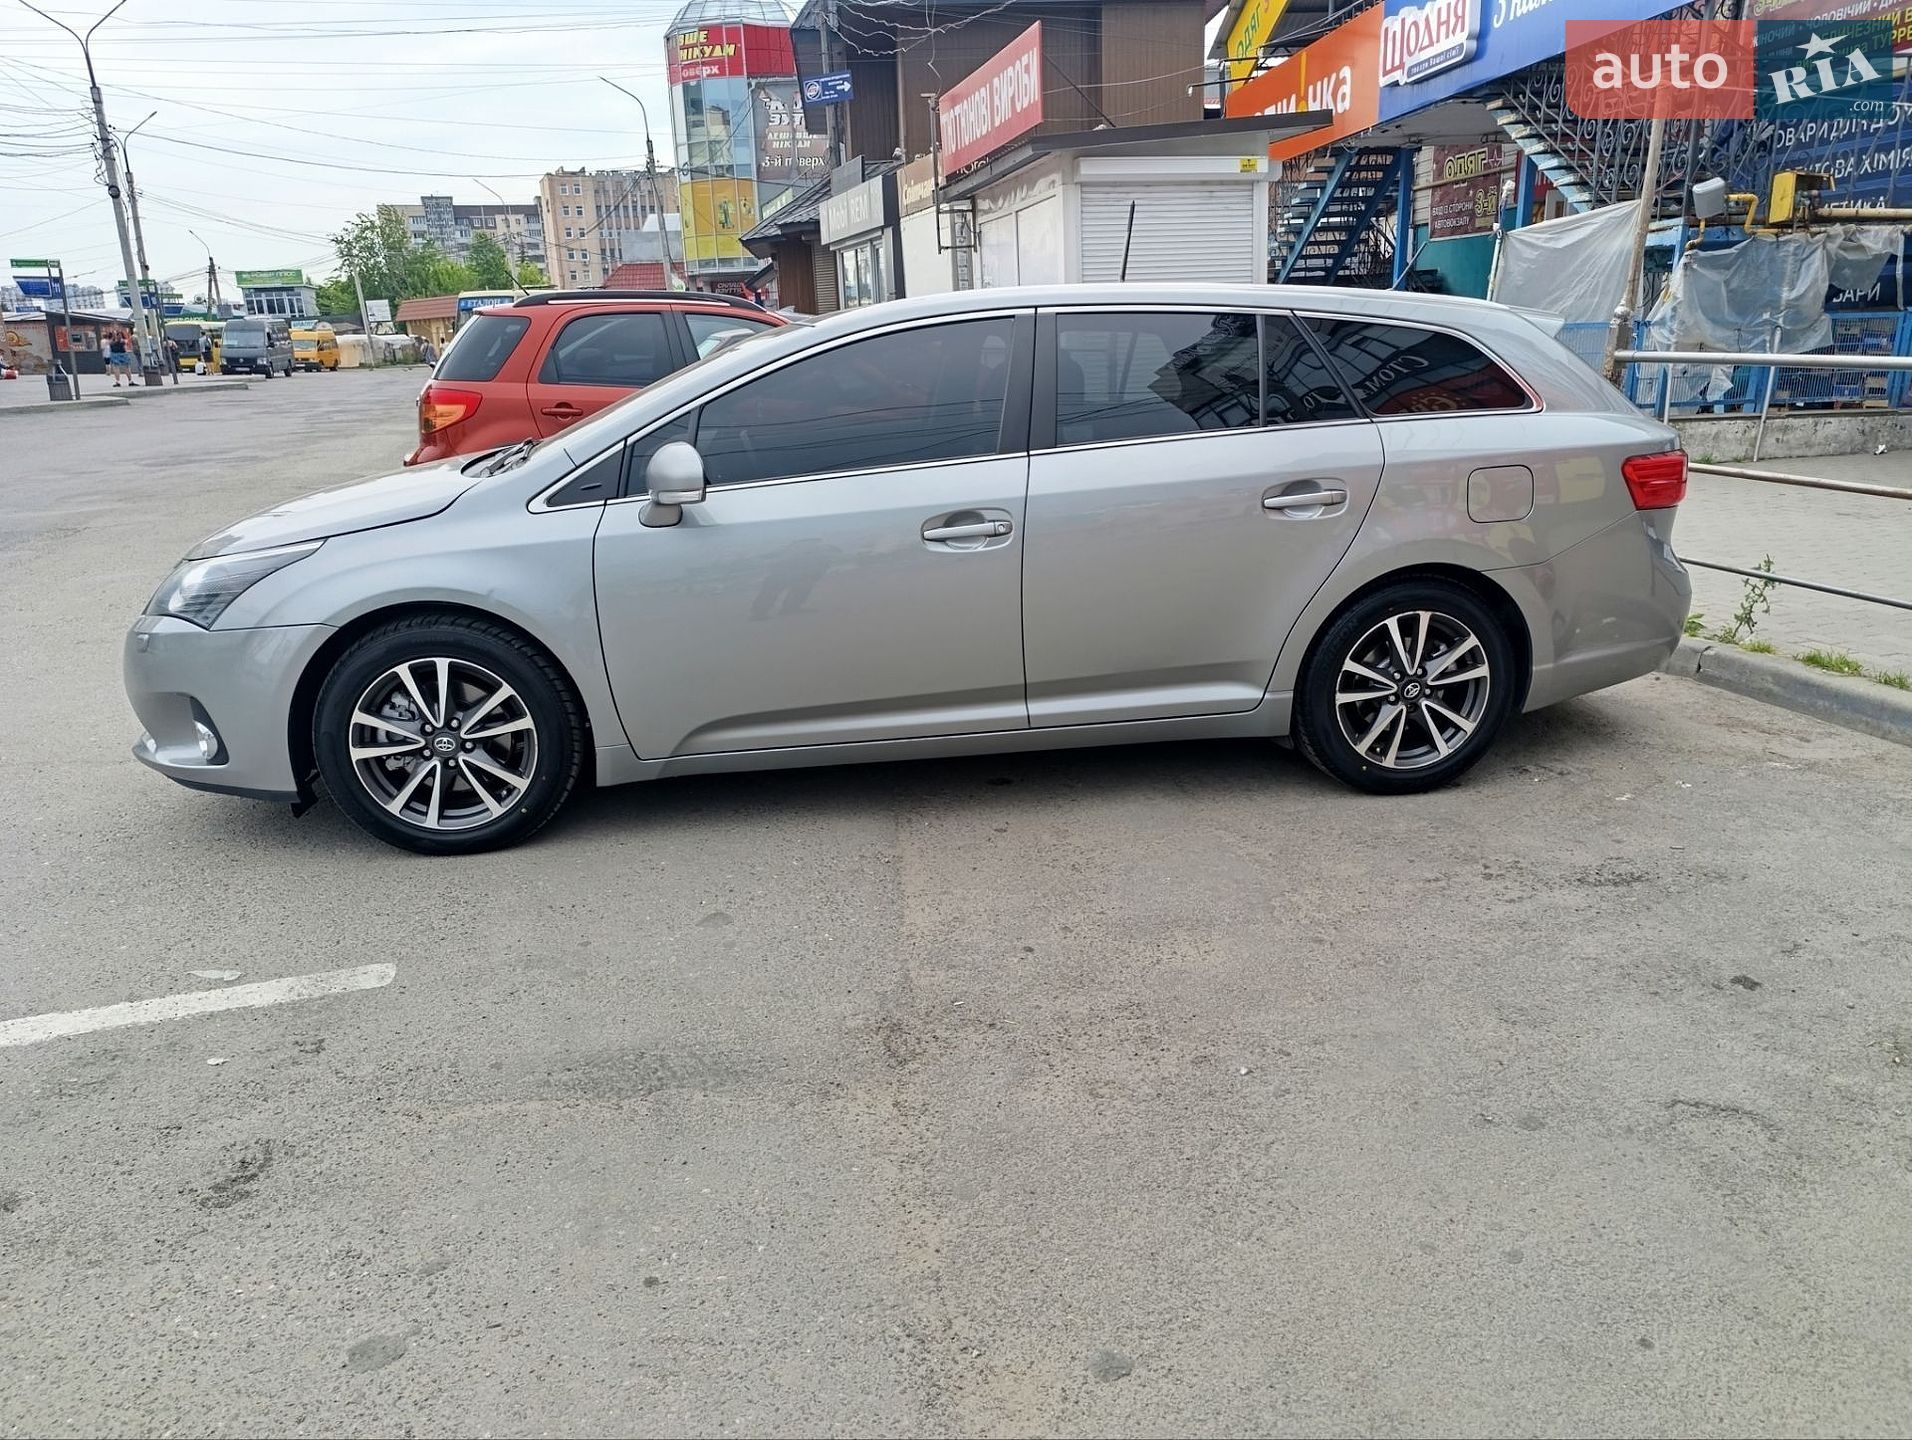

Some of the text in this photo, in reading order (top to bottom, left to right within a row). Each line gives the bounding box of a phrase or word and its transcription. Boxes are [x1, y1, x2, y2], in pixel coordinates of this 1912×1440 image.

[1235, 4, 1262, 65] ОДЯГ
[1818, 9, 1901, 42] ЕЛИЧЕЗНИЙ
[992, 47, 1038, 128] ВИРОБИ
[785, 156, 826, 169] пверх
[1444, 147, 1488, 187] ОДЯГ
